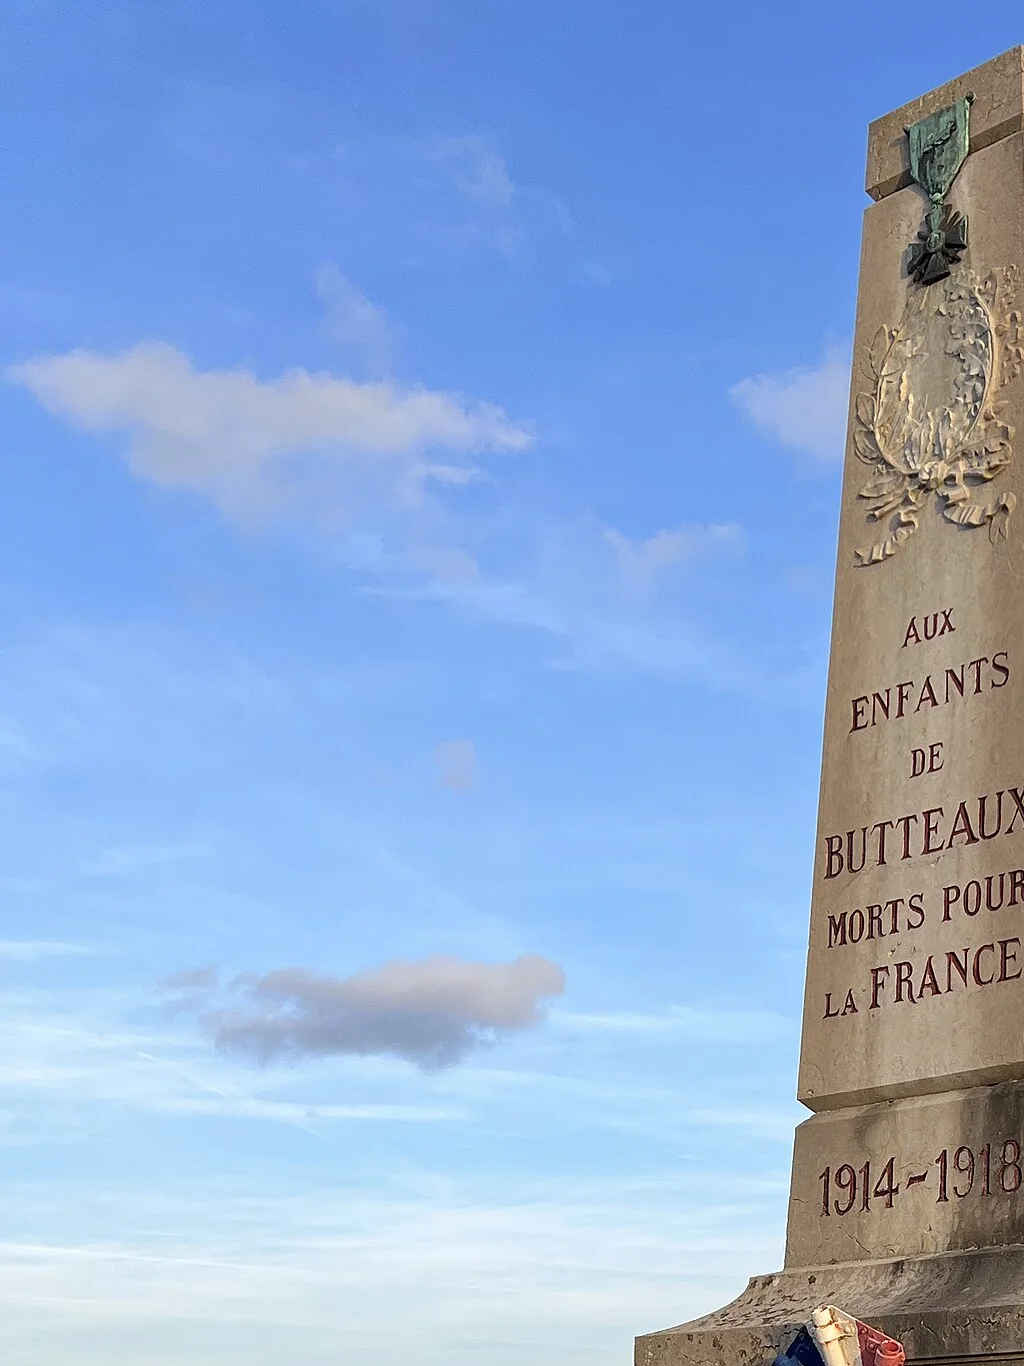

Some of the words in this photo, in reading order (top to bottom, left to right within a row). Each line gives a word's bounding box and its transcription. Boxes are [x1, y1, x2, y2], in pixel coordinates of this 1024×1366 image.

[901, 608, 955, 648] AUX
[848, 652, 1010, 733] ENFANTS
[909, 742, 944, 779] DE
[827, 892, 924, 949] MORTS
[823, 988, 858, 1019] LA
[869, 937, 1022, 1009] FRANCE
[819, 1140, 1022, 1217] 1914-1918
